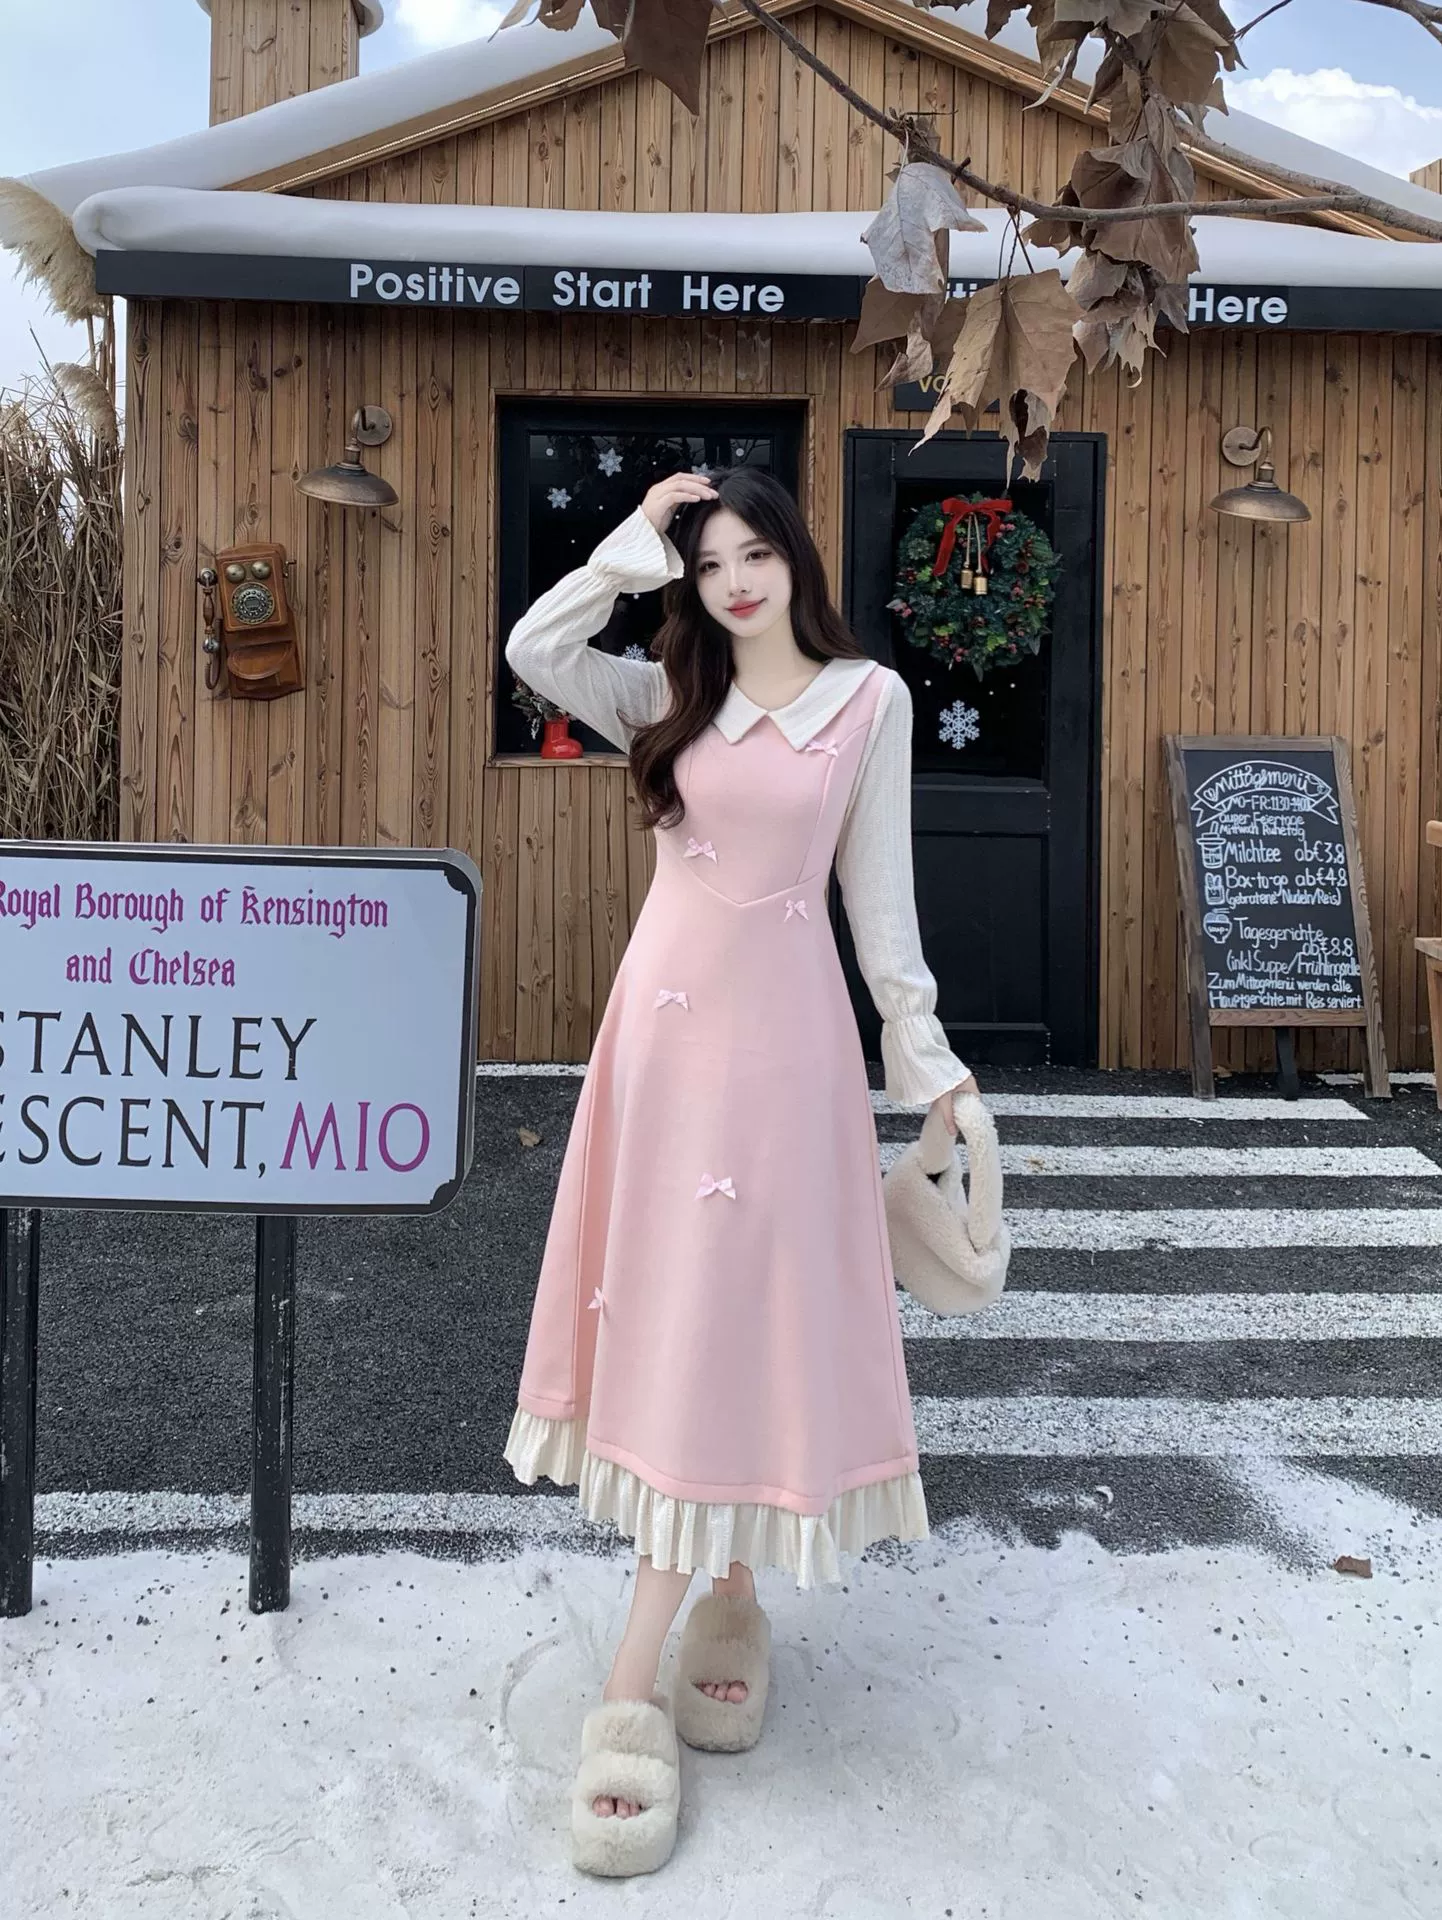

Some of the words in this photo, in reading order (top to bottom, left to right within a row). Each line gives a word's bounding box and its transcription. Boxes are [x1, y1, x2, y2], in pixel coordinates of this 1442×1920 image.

[349, 263, 521, 305] Positive
[552, 271, 652, 308] Start
[682, 275, 786, 313] Here
[1187, 287, 1289, 325] Here
[1223, 840, 1282, 864] Milchtee
[1225, 865, 1289, 896] Box-to-go
[75, 882, 184, 934] Borough
[200, 887, 231, 924] of
[240, 885, 388, 939] Kensington
[66, 947, 112, 984] and
[129, 948, 236, 988] Chelsea
[0, 1010, 318, 1081] TANLEY
[0, 1093, 266, 1178] SCENT,
